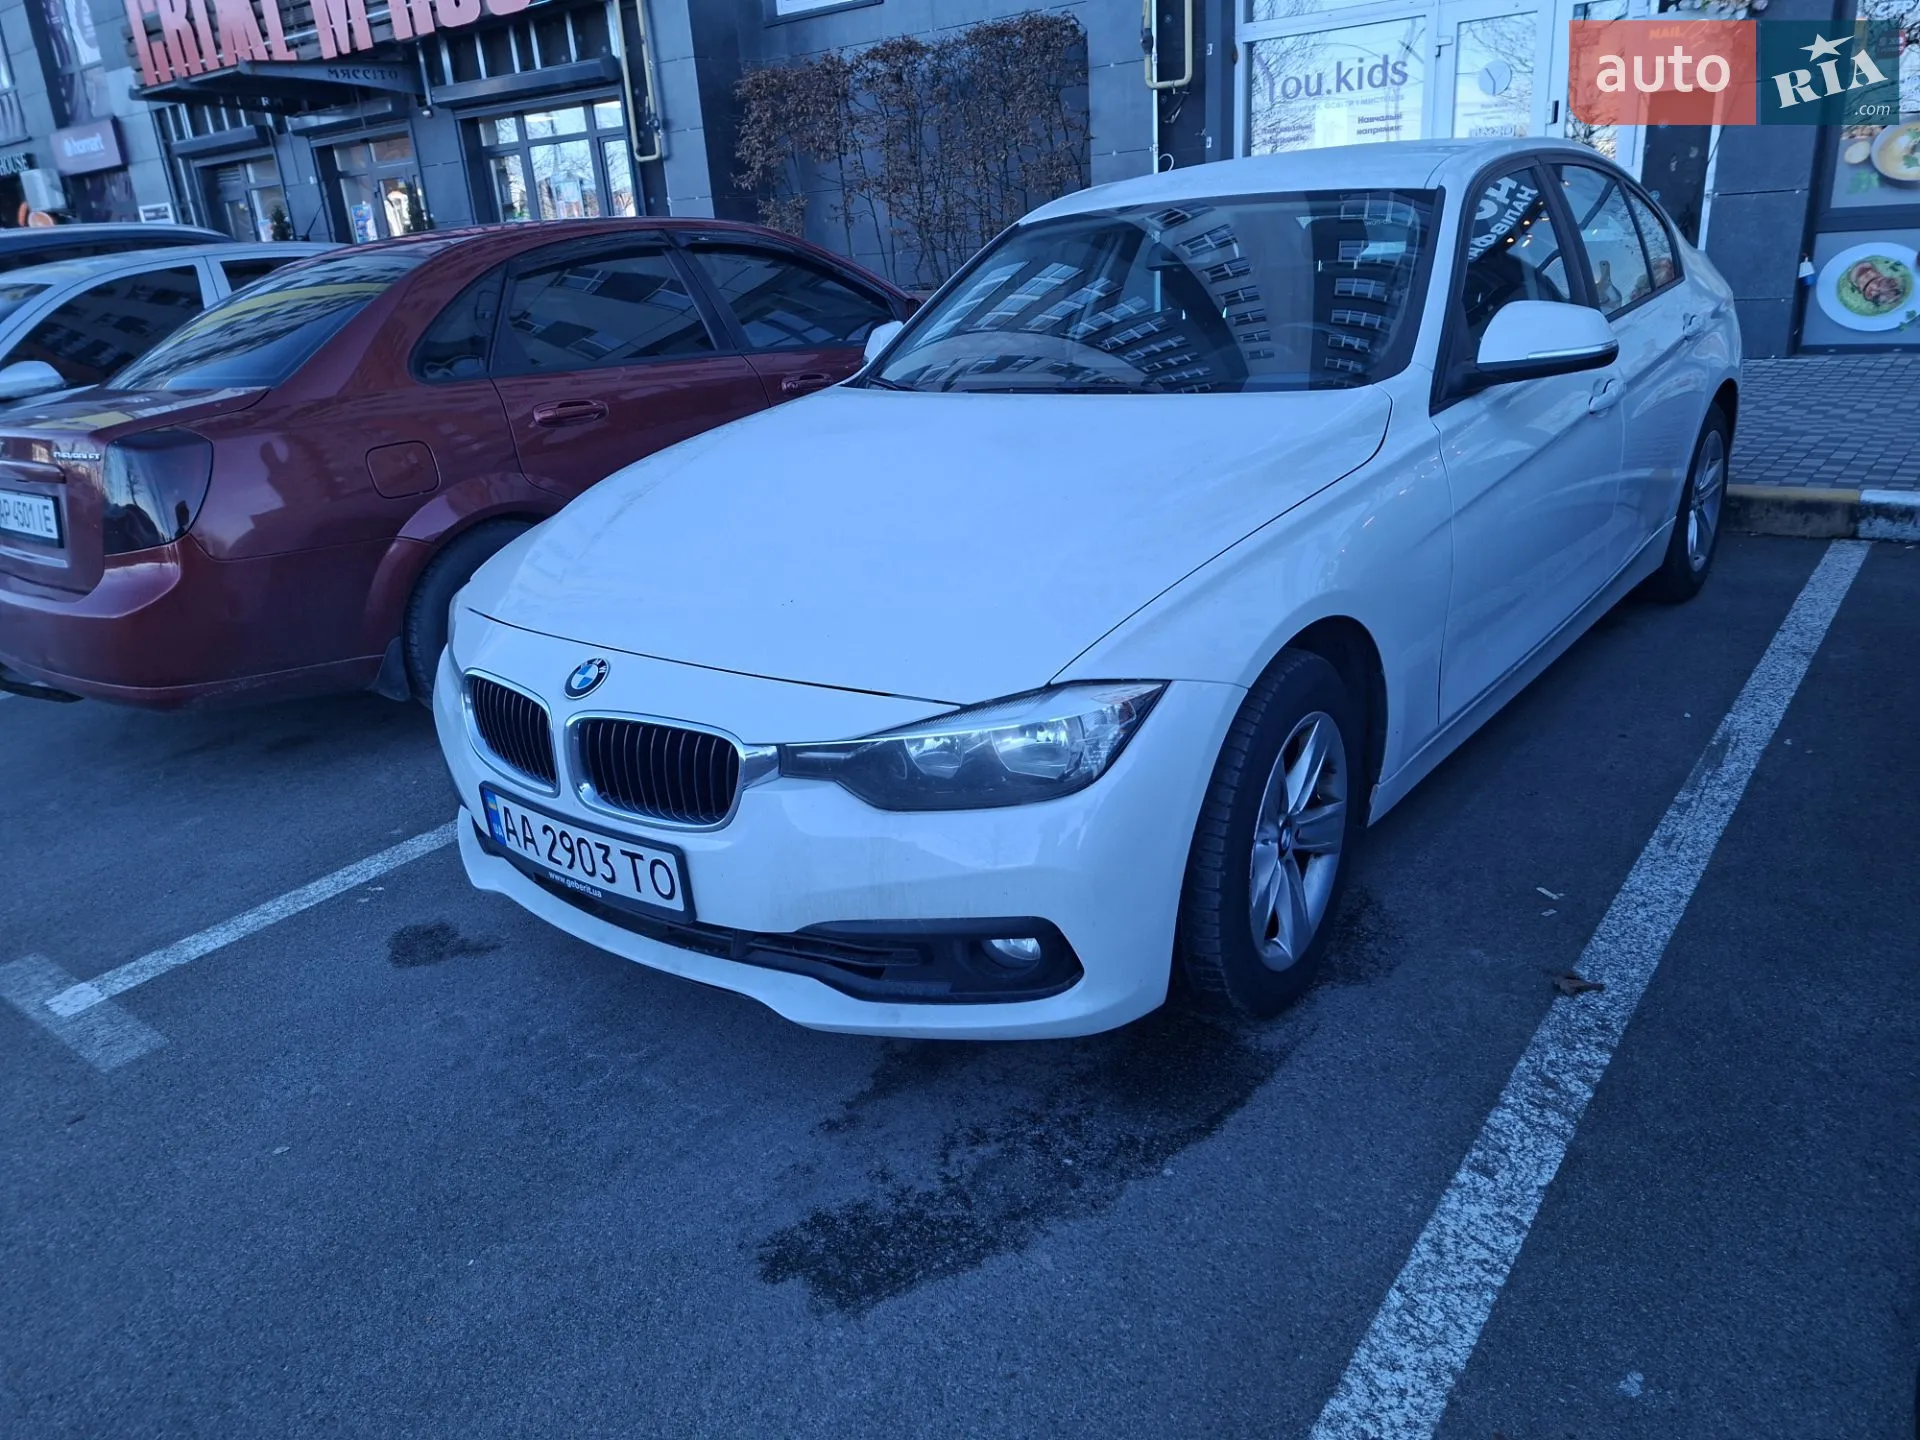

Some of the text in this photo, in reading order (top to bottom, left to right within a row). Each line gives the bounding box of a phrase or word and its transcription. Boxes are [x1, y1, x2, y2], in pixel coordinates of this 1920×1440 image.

[1255, 54, 1409, 102] You.kids
[503, 806, 676, 900] AA 2903 TO
[548, 871, 602, 898] www.geberit.ua
